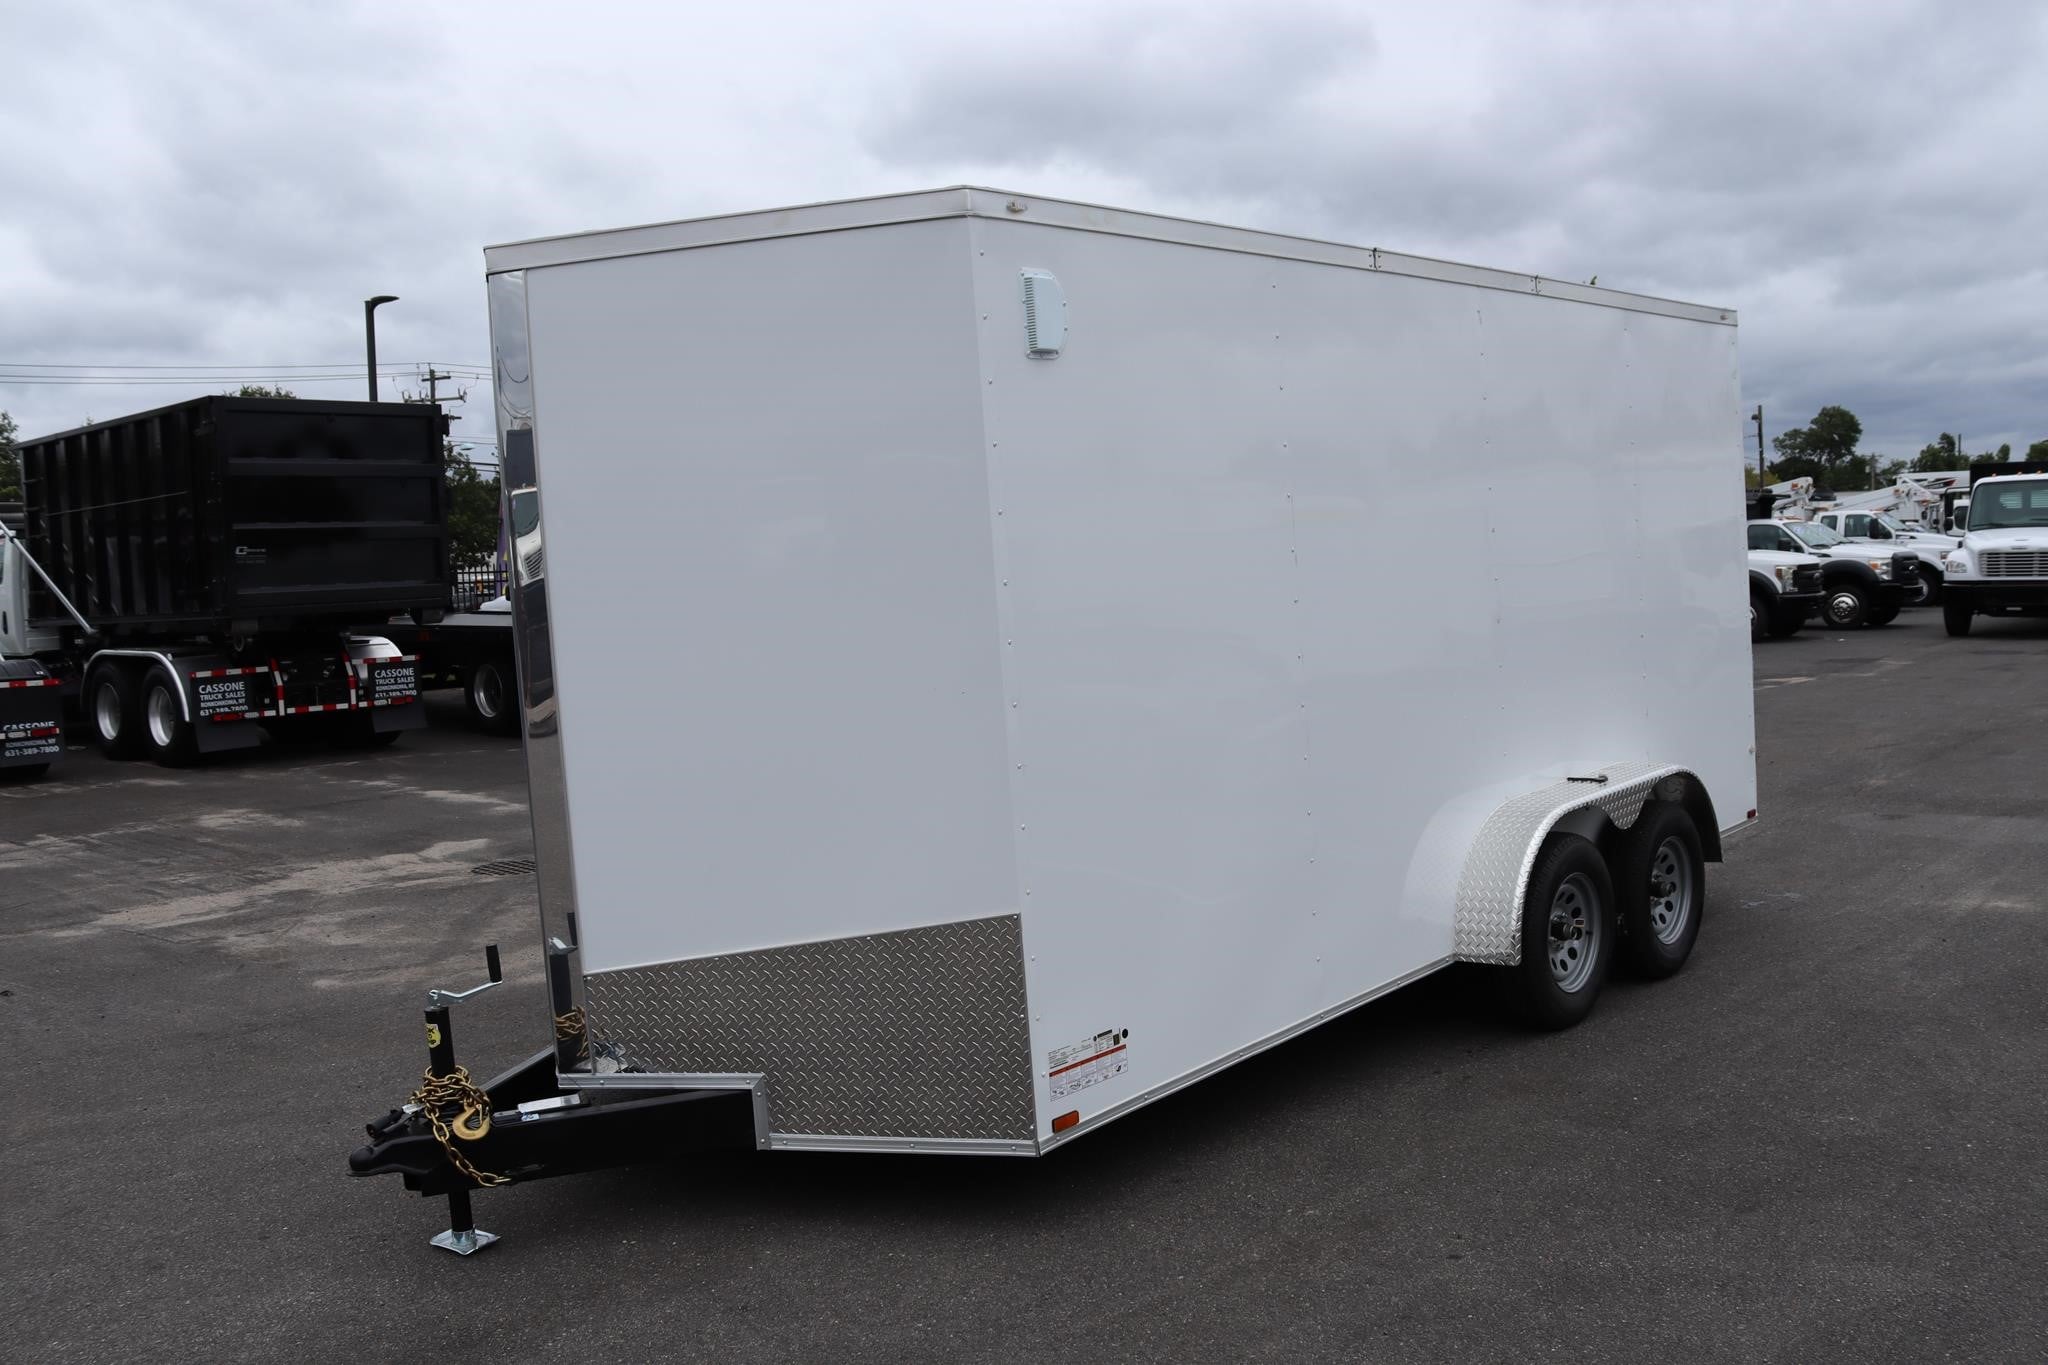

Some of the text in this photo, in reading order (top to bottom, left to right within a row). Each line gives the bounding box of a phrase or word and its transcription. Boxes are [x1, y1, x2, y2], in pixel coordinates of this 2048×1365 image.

[375, 667, 415, 678] CASSONE
[397, 676, 415, 684] SALES
[199, 682, 245, 693] CASSONE
[200, 693, 223, 701] TRUCK
